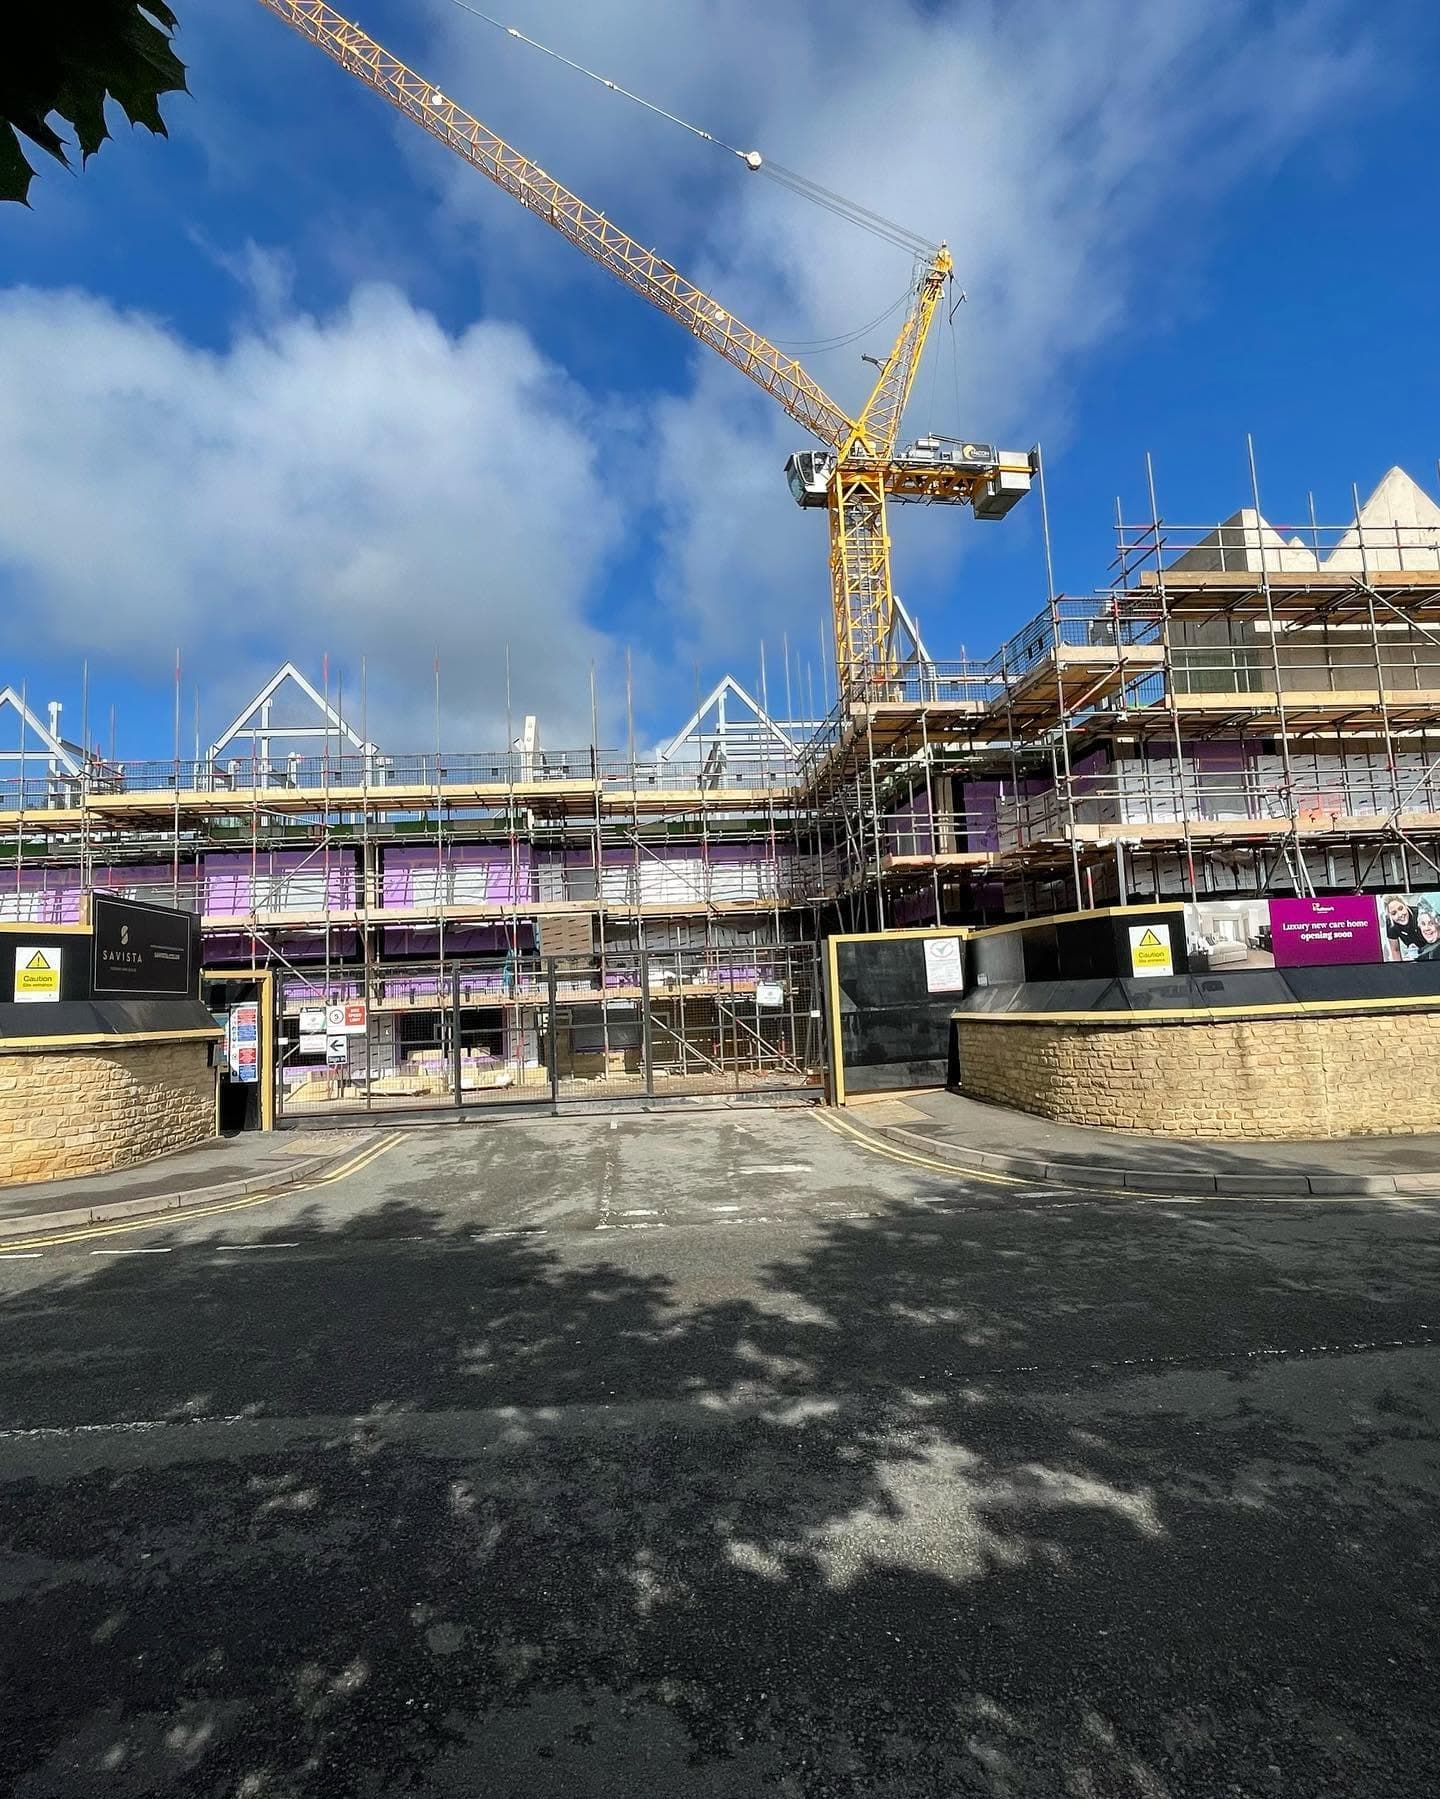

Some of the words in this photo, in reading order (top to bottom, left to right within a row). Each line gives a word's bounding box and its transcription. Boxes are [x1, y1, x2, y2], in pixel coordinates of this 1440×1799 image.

[1282, 922, 1309, 931] Luxury
[1311, 922, 1328, 930] new
[1329, 920, 1346, 929] care
[1346, 920, 1369, 928] home
[1300, 930, 1333, 941] opening
[1333, 930, 1353, 938] soon
[102, 950, 142, 963] SAVISTA
